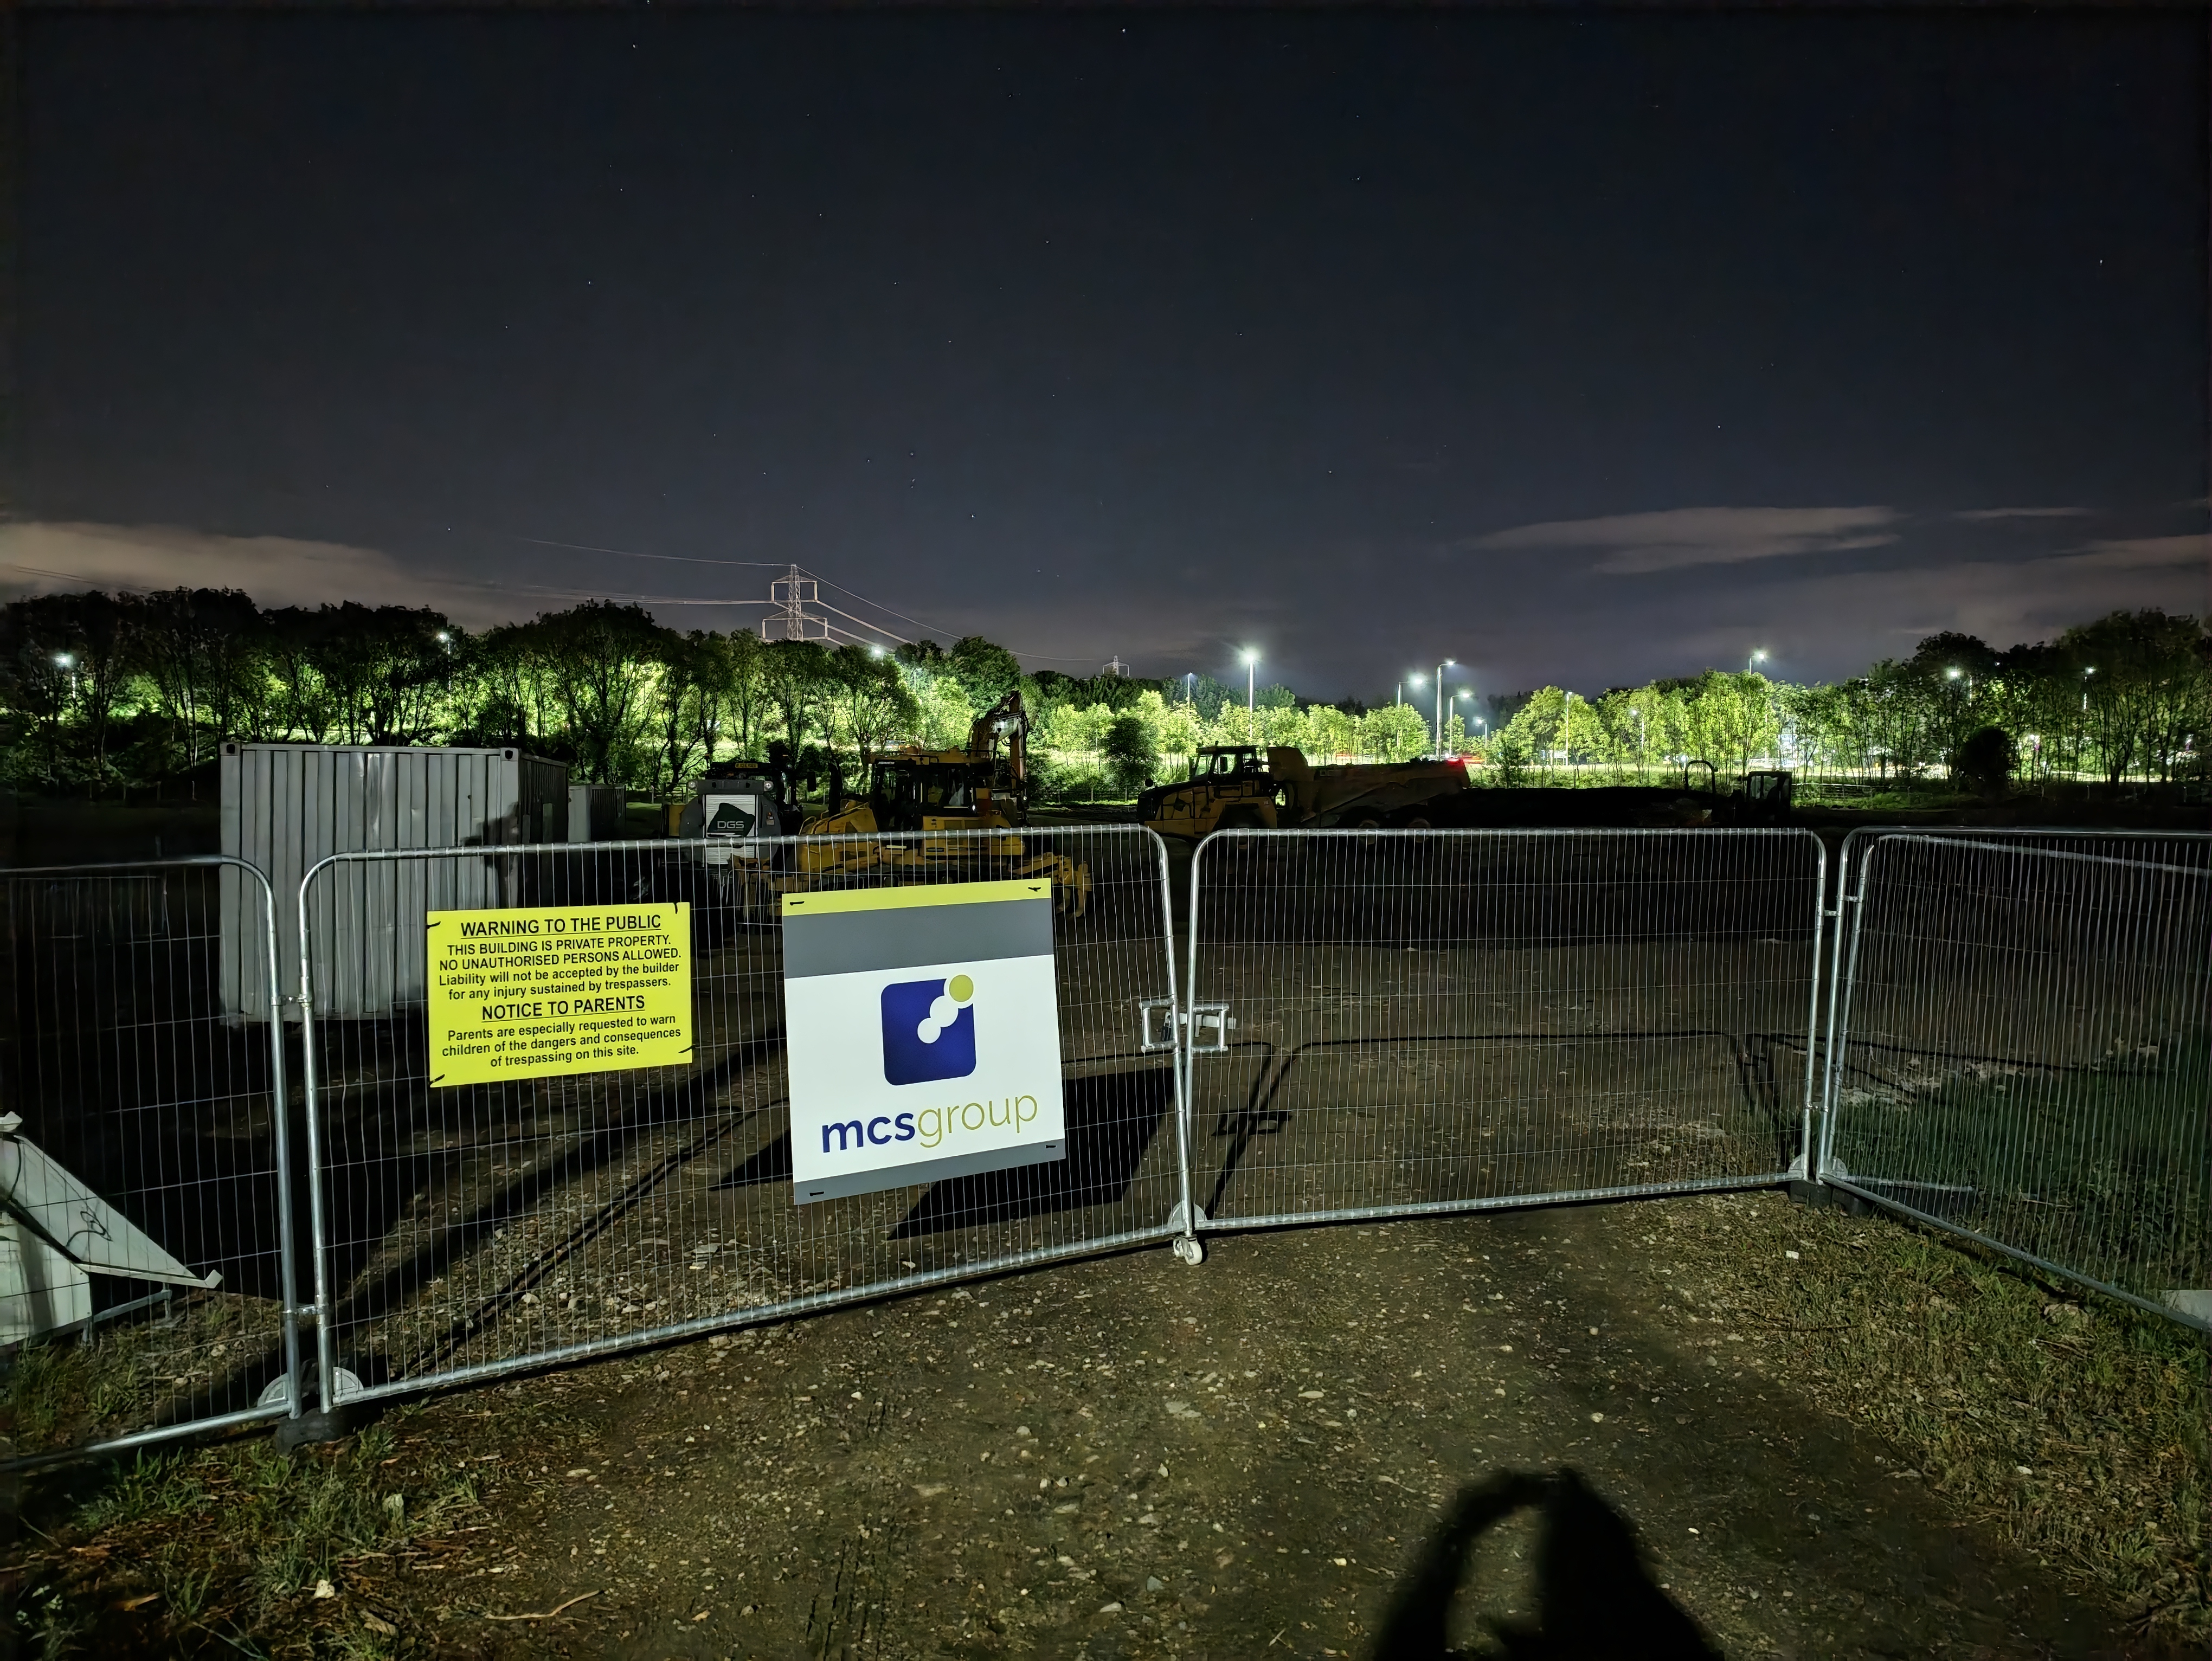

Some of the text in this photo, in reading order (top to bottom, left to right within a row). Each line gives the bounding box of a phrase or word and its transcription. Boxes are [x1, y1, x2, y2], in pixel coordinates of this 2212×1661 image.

[717, 821, 745, 829] DGS
[461, 915, 660, 936] WARNING TO THE PUBLIC
[447, 935, 671, 956] THIS BUILDING IS PRIVATE PROPERTY.
[440, 948, 681, 971] NO UNAUTHORISED PERSONS ALLOWED.
[440, 962, 679, 986] Liability will not be accepted by the builder
[449, 978, 671, 1001] for any injury sustained by trespassers.
[483, 995, 645, 1020] NOTICE TO PARENTS
[448, 1016, 676, 1041] Parents are especially requested to warn
[442, 1029, 681, 1056] children of the dangers and consequences
[491, 1045, 639, 1067] of trespassing on this site.
